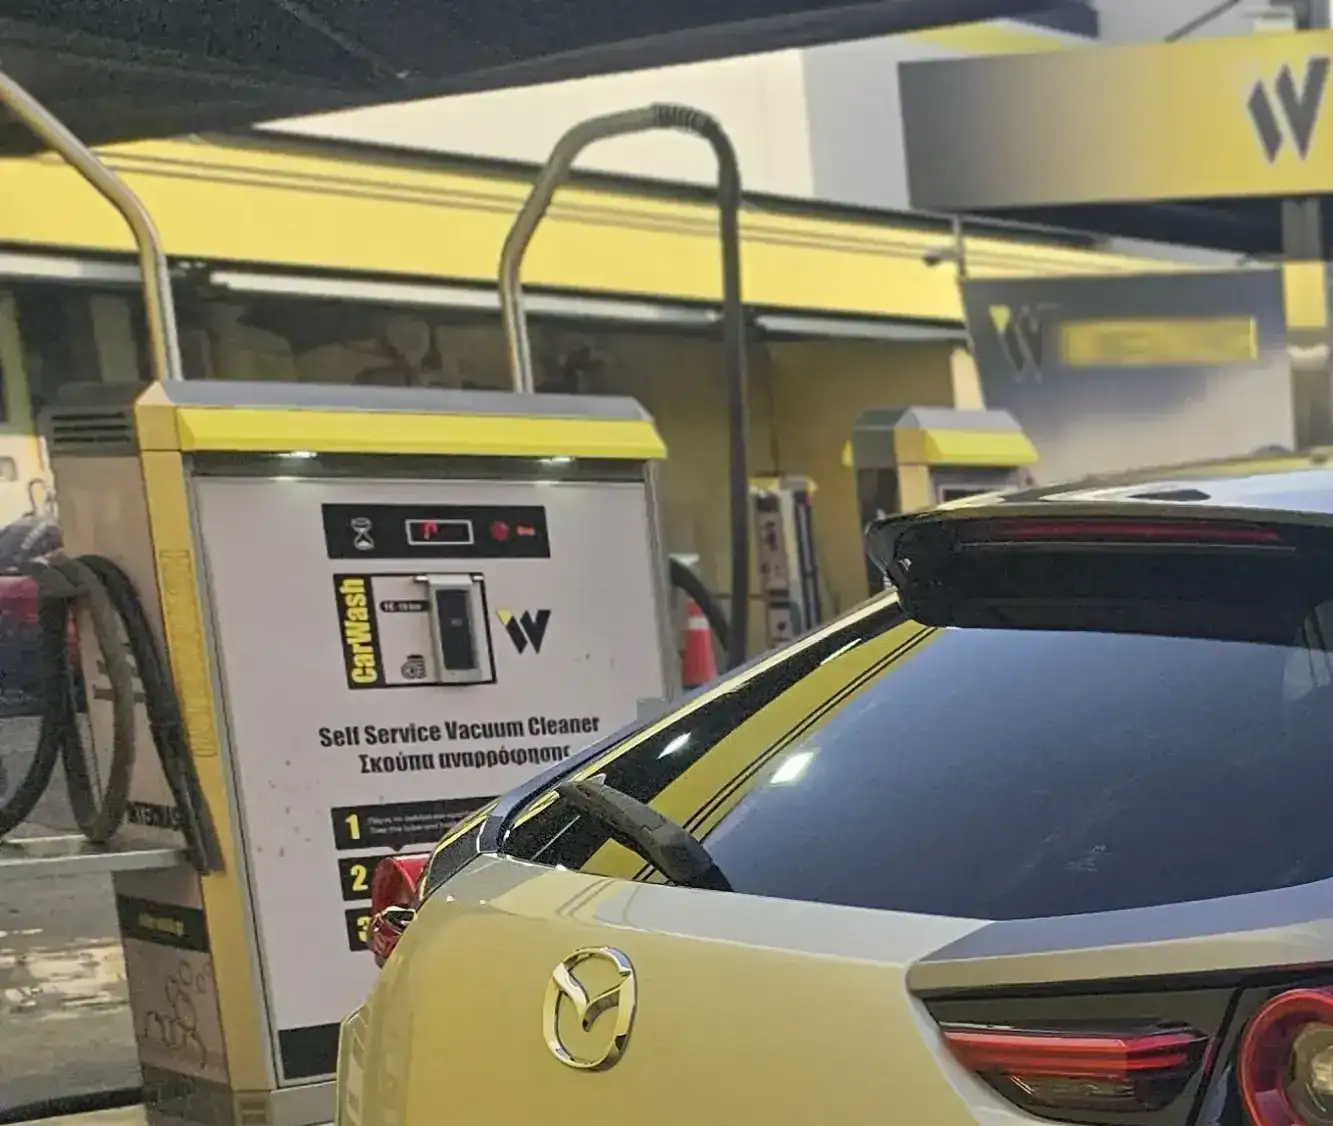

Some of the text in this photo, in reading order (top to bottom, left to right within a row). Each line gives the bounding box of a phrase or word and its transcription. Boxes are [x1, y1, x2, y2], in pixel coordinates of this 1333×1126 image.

[339, 578, 378, 684] CarWash
[318, 715, 601, 748] Self Service Vacuum Cleaner
[359, 751, 436, 774] Σκούπα
[345, 813, 361, 840] 1
[350, 864, 369, 891] 2
